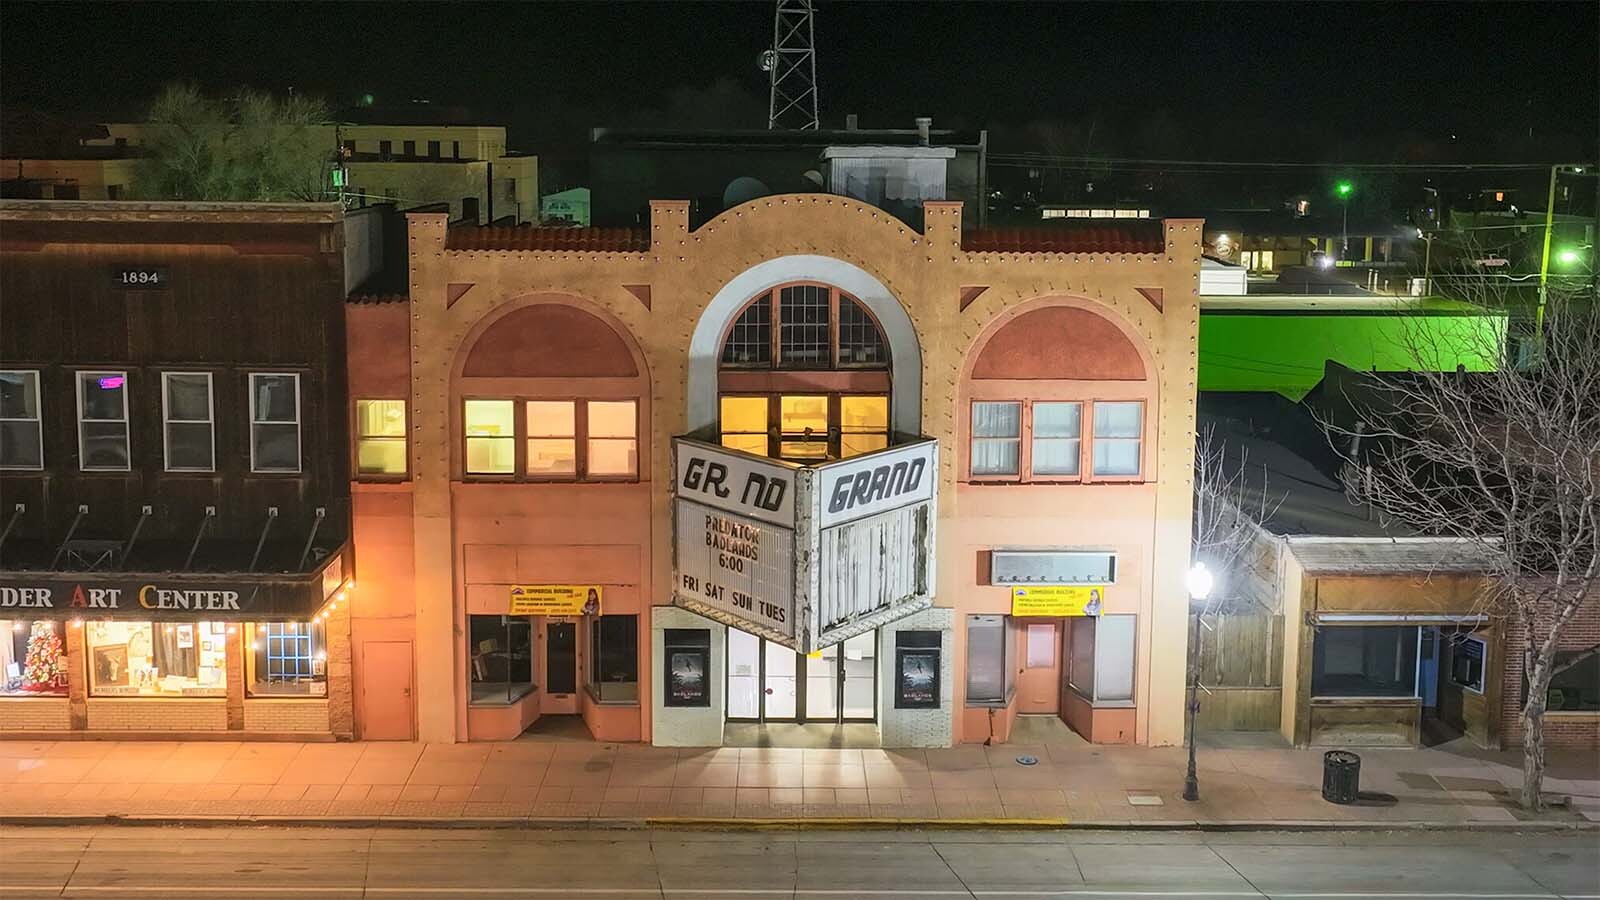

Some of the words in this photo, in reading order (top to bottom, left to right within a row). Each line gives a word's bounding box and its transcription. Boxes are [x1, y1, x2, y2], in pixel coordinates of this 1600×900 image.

[122, 272, 158, 283] 1894
[828, 457, 926, 513] GRAND
[705, 532, 758, 560] BADLANDS
[719, 553, 743, 573] 6:00
[0, 587, 53, 608] DER
[69, 584, 121, 608] ART
[139, 585, 240, 610] CENTER
[683, 575, 699, 592] FRI
[705, 583, 725, 600] SAT
[732, 592, 752, 611] SUN
[759, 600, 785, 623] TUES
